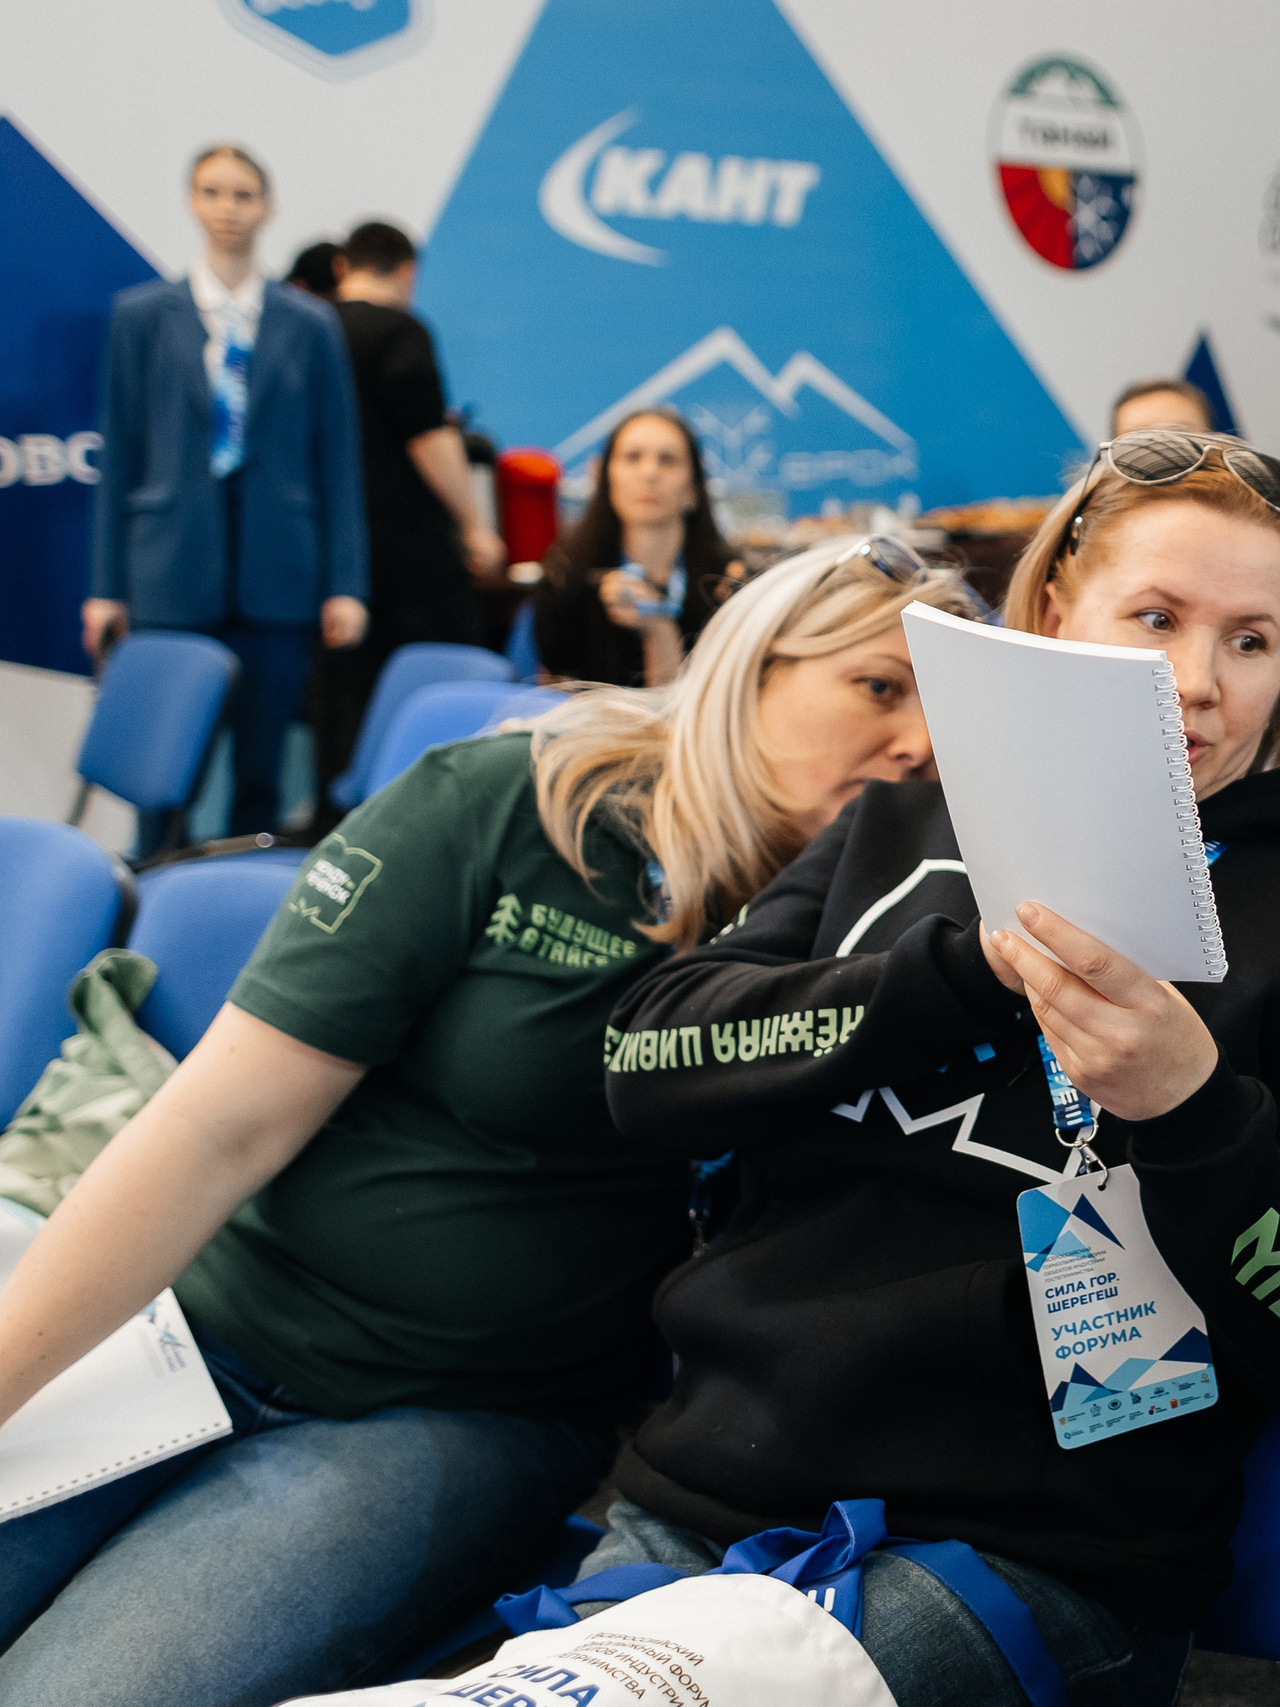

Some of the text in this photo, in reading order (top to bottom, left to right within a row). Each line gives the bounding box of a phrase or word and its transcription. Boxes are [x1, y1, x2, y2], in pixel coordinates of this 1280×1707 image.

[590, 144, 821, 229] КАНТ
[1045, 1272, 1120, 1299] СИЛА ГОР.
[1047, 1286, 1119, 1314] ШЕРЕГЕШ
[1051, 1301, 1157, 1341] УЧАСТНИК
[1055, 1326, 1142, 1359] ФОРУМА
[487, 1664, 601, 1707] СИЛА
